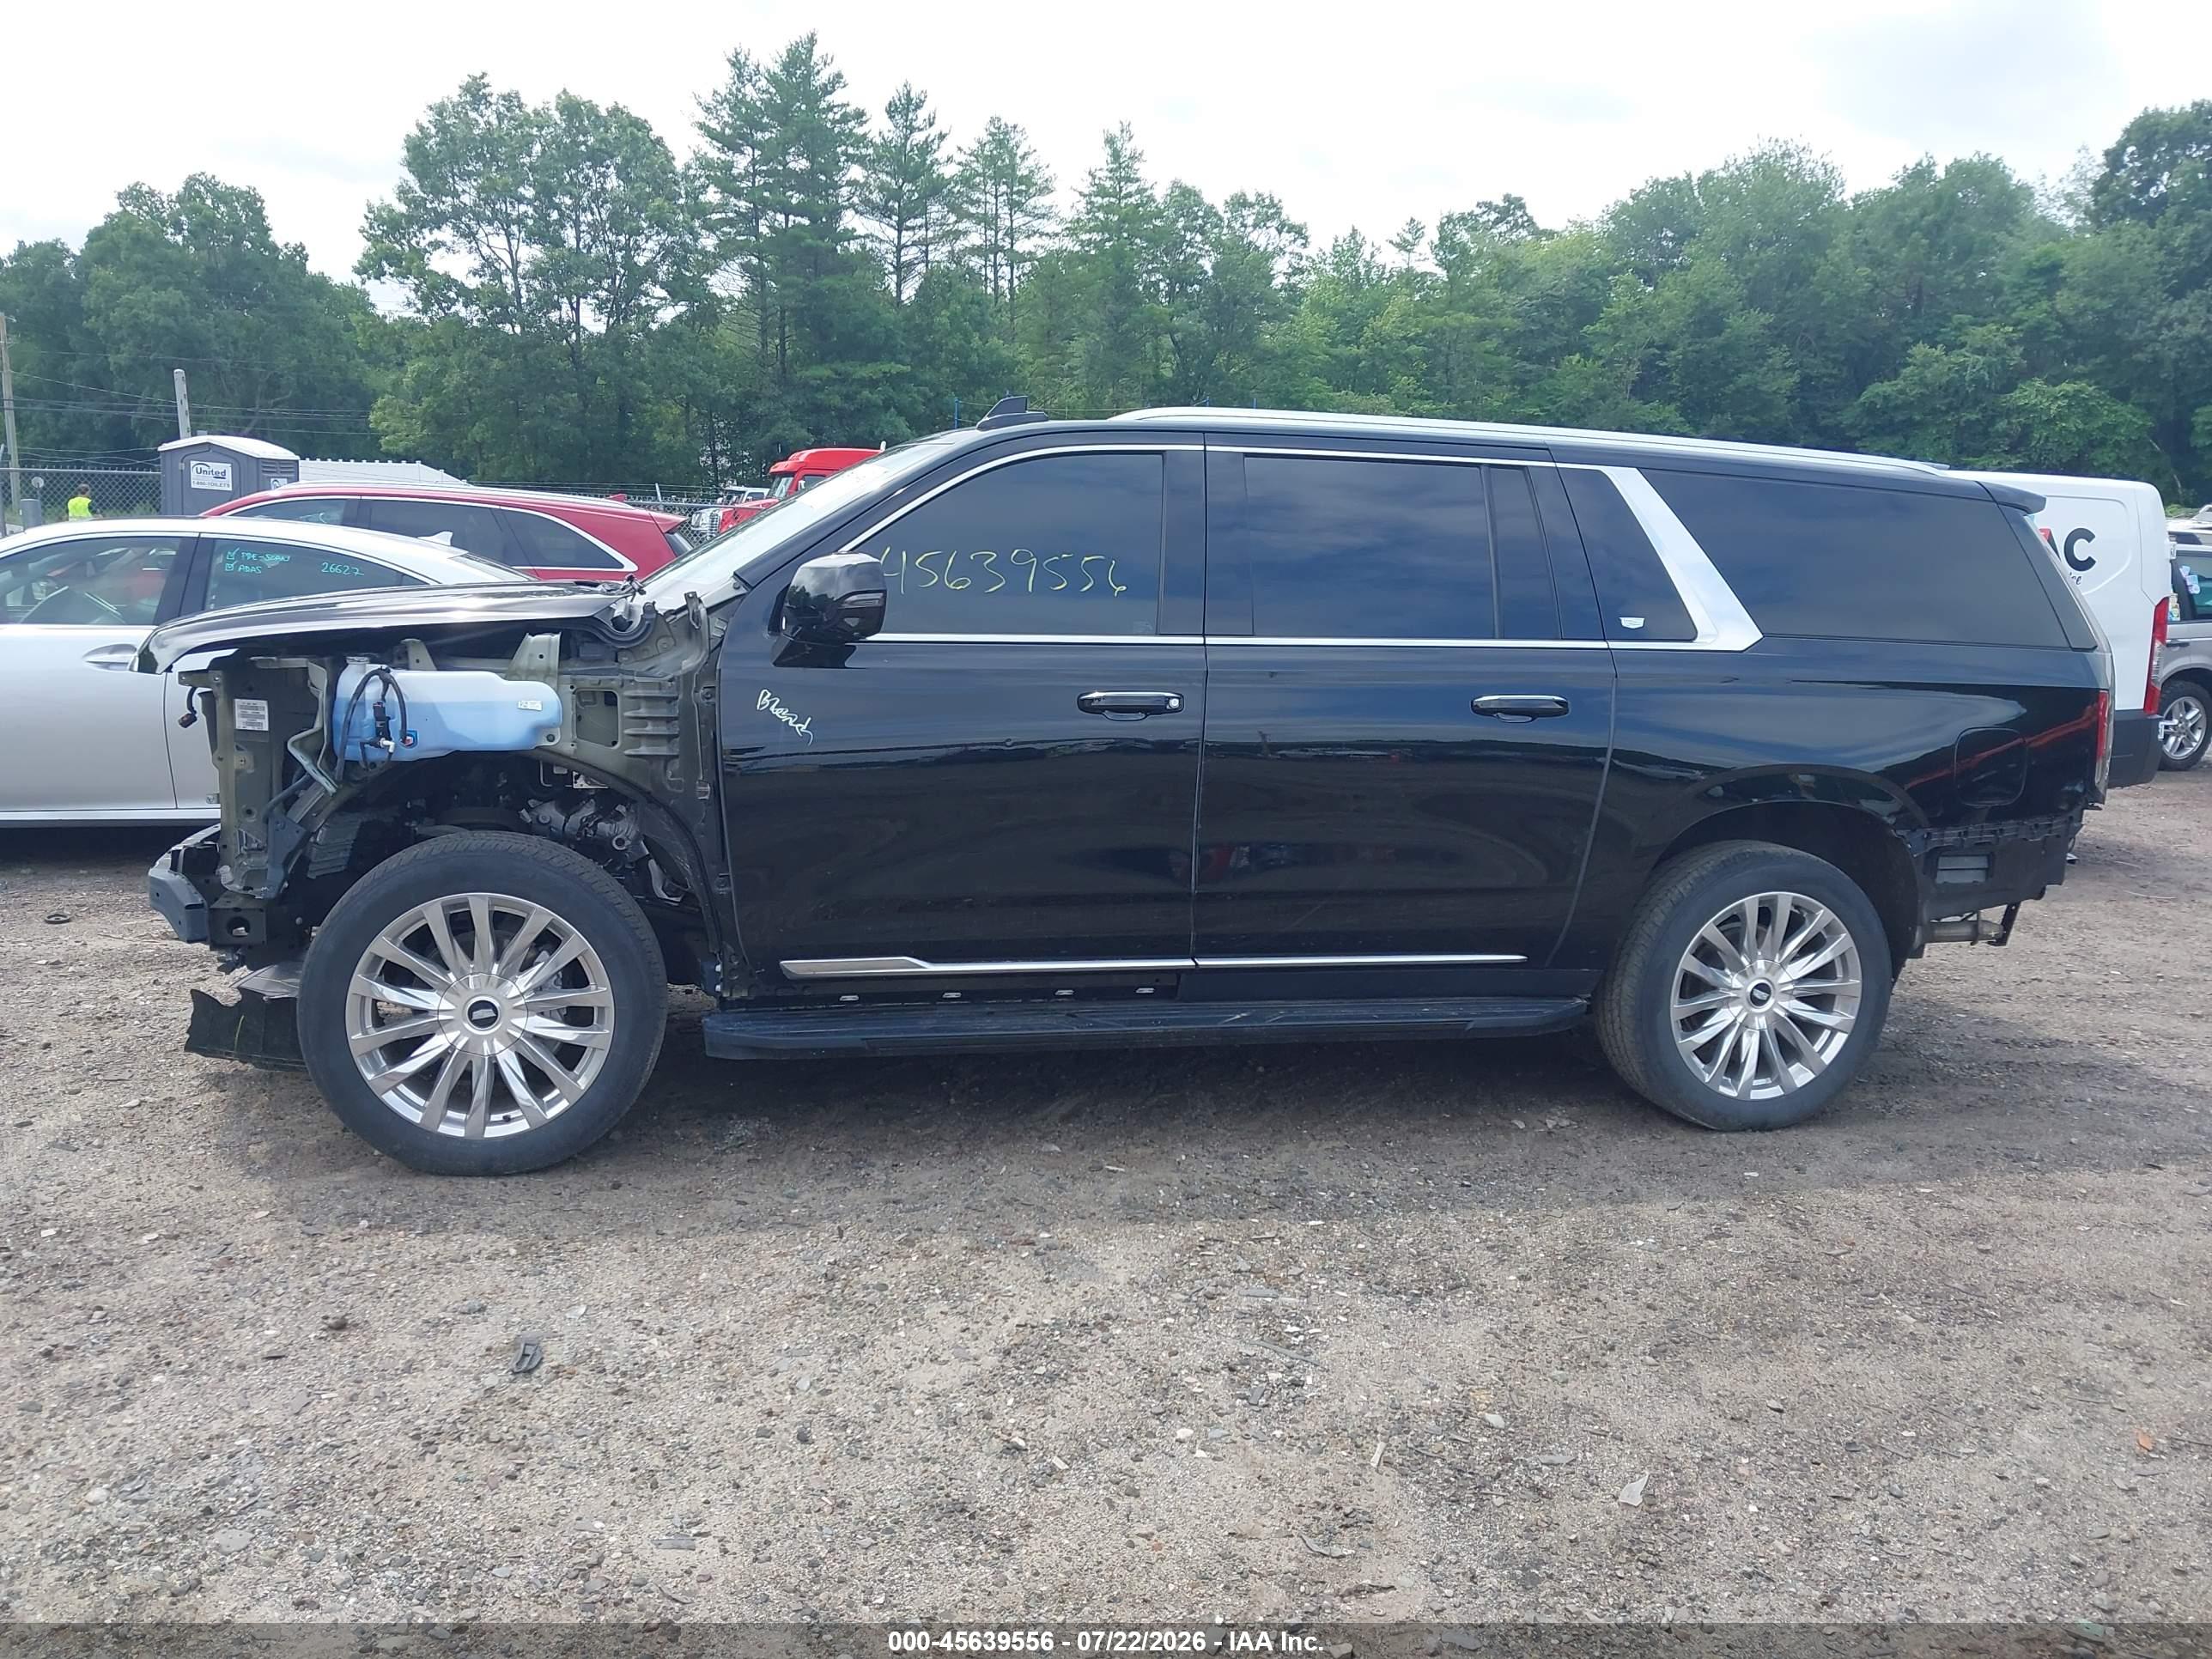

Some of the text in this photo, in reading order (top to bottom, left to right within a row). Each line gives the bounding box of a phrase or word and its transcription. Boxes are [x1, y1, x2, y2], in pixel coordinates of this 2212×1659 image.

[195, 466, 227, 477] United
[321, 562, 365, 576] 26627
[880, 546, 1127, 597] 45639556
